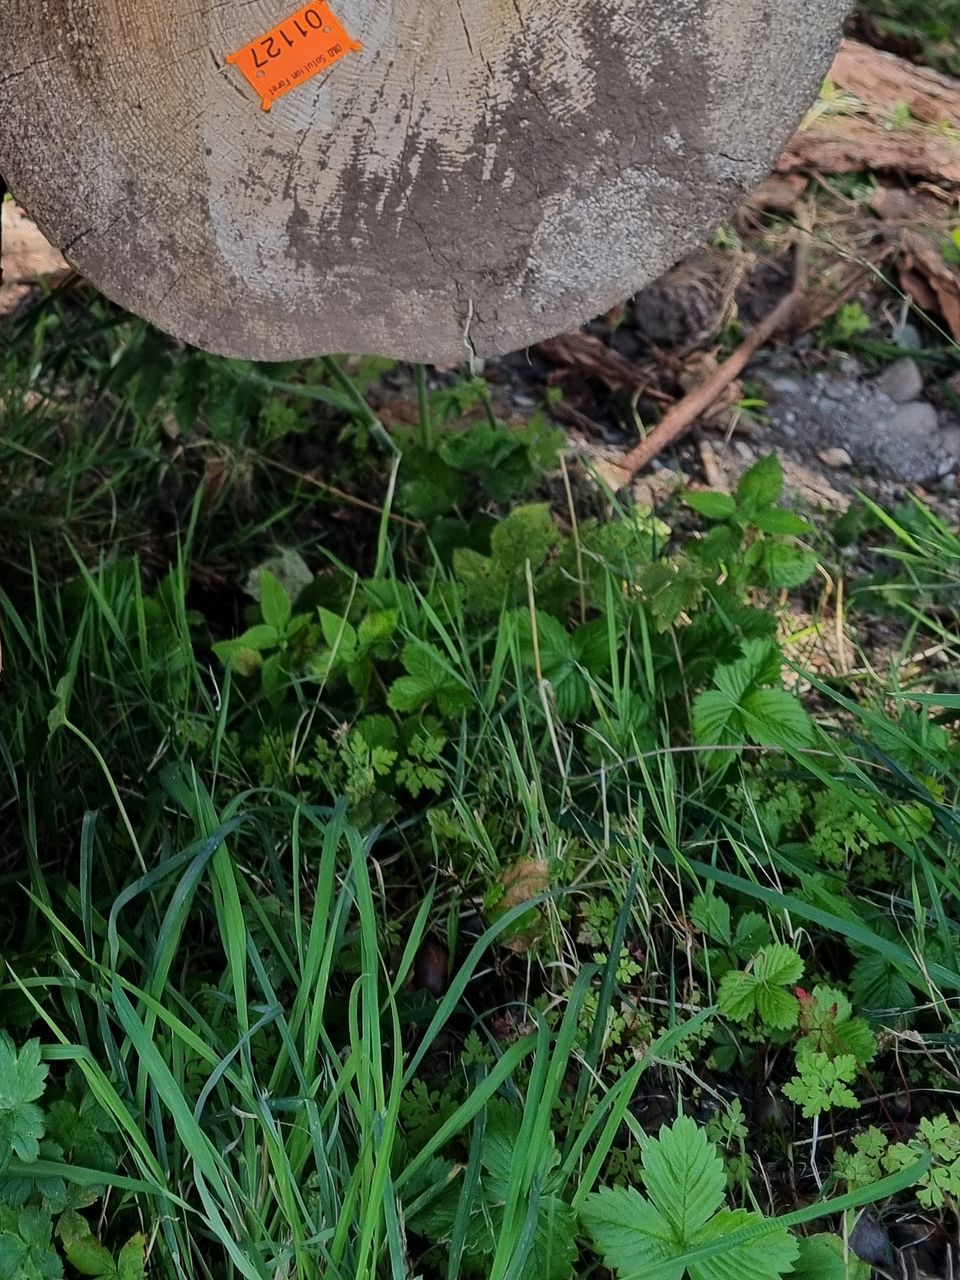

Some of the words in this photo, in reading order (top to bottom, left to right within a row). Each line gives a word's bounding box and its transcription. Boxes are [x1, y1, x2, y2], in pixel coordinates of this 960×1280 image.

[251, 9, 323, 68] 01127
[327, 43, 343, 58] D&D
[291, 54, 327, 79] Solution
[268, 78, 291, 95] Foret
